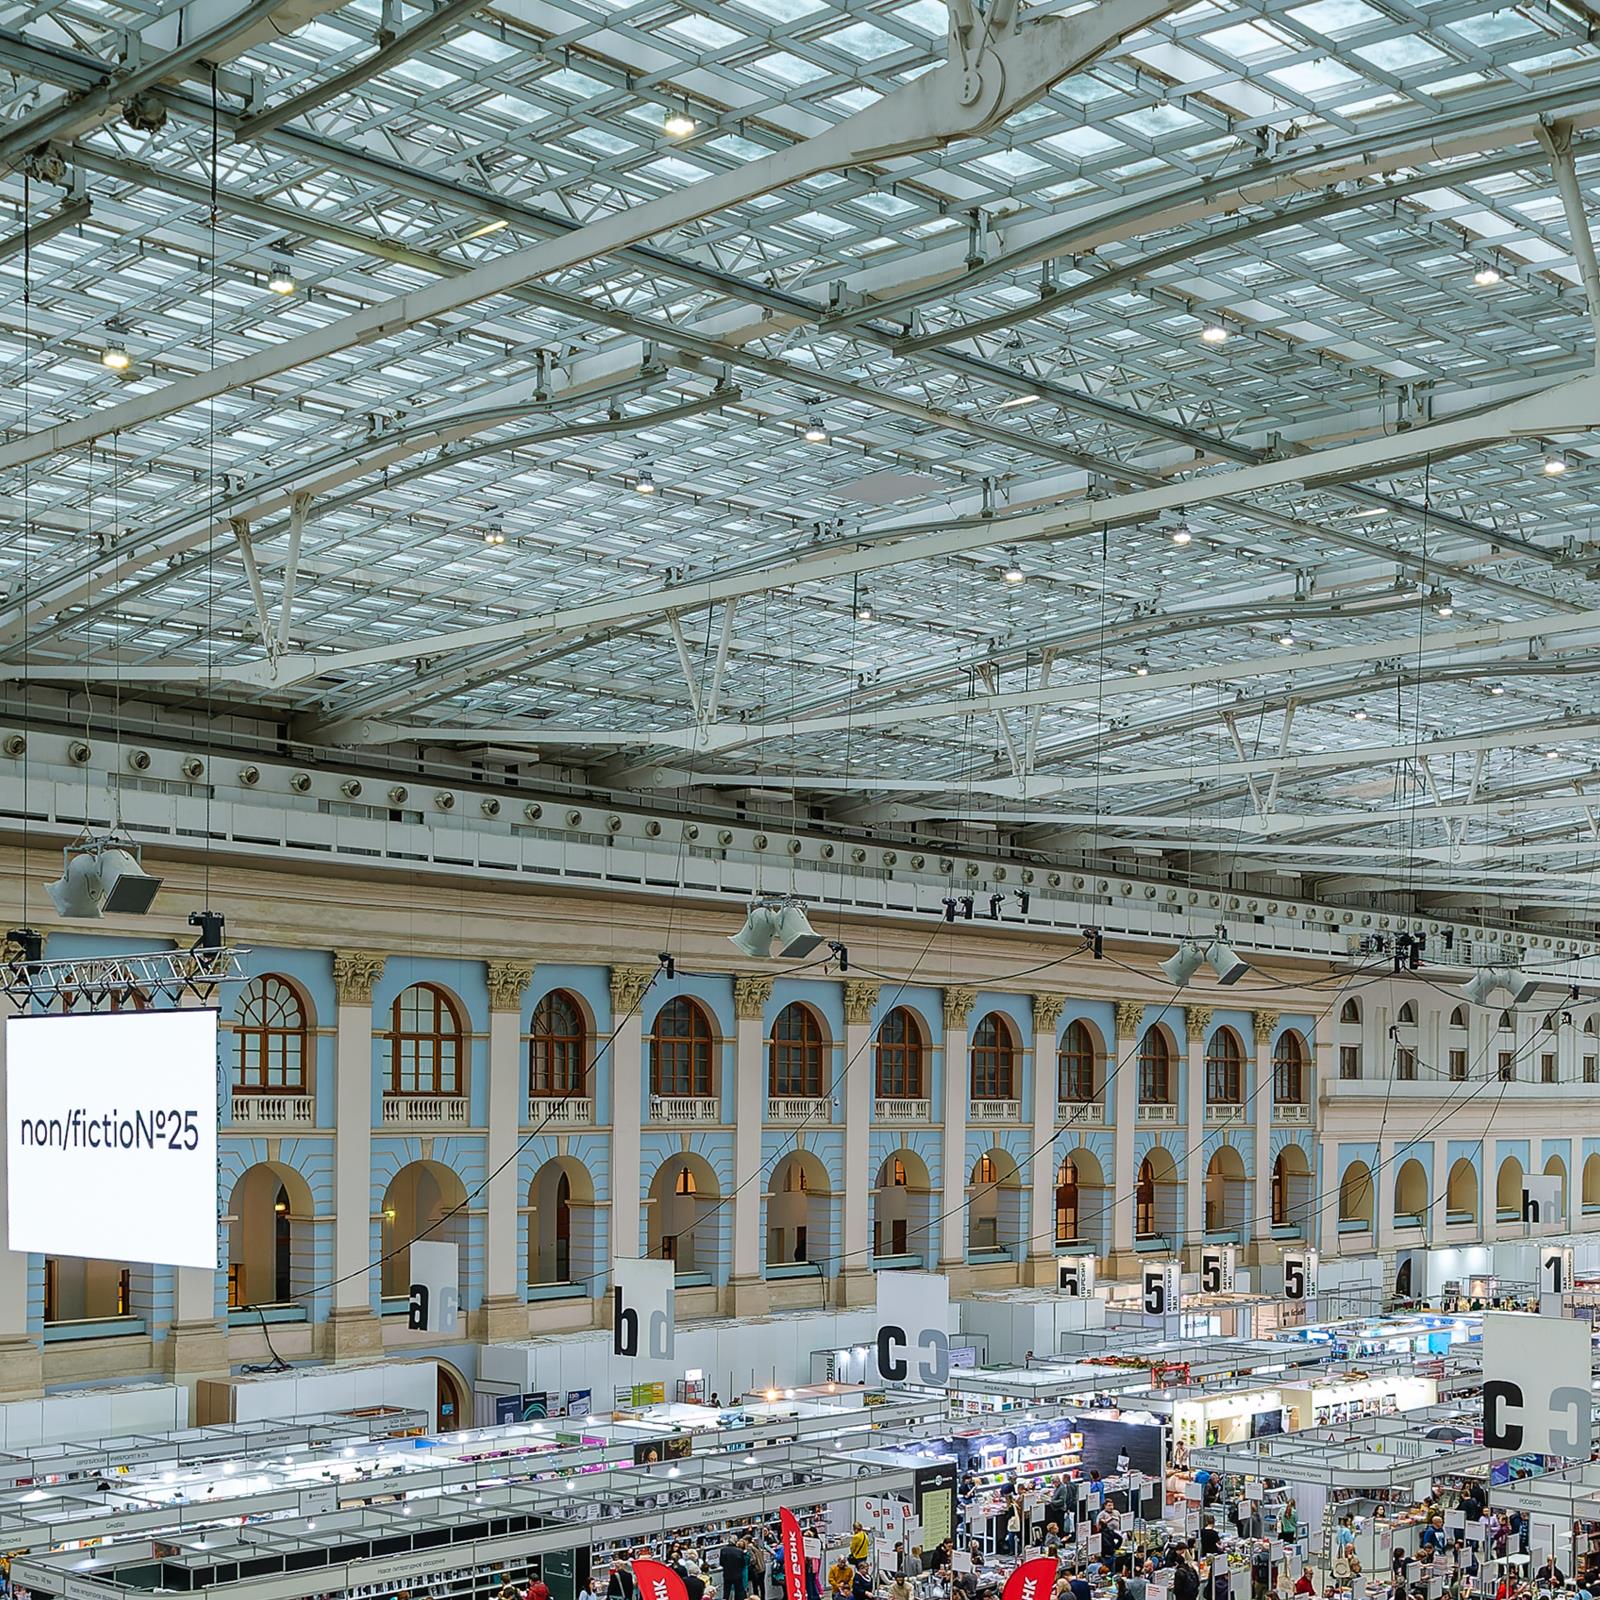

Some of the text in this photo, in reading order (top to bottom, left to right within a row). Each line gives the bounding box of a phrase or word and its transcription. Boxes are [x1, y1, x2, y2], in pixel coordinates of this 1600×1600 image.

[1060, 1267, 1077, 1296] 5
[1145, 1273, 1164, 1314] 5
[1203, 1255, 1221, 1292] 5
[1285, 1261, 1303, 1299] 5
[1545, 1256, 1561, 1293] 1
[409, 1284, 429, 1331] a
[614, 1286, 638, 1356] b
[877, 1325, 907, 1381] c
[1483, 1380, 1524, 1451] c
